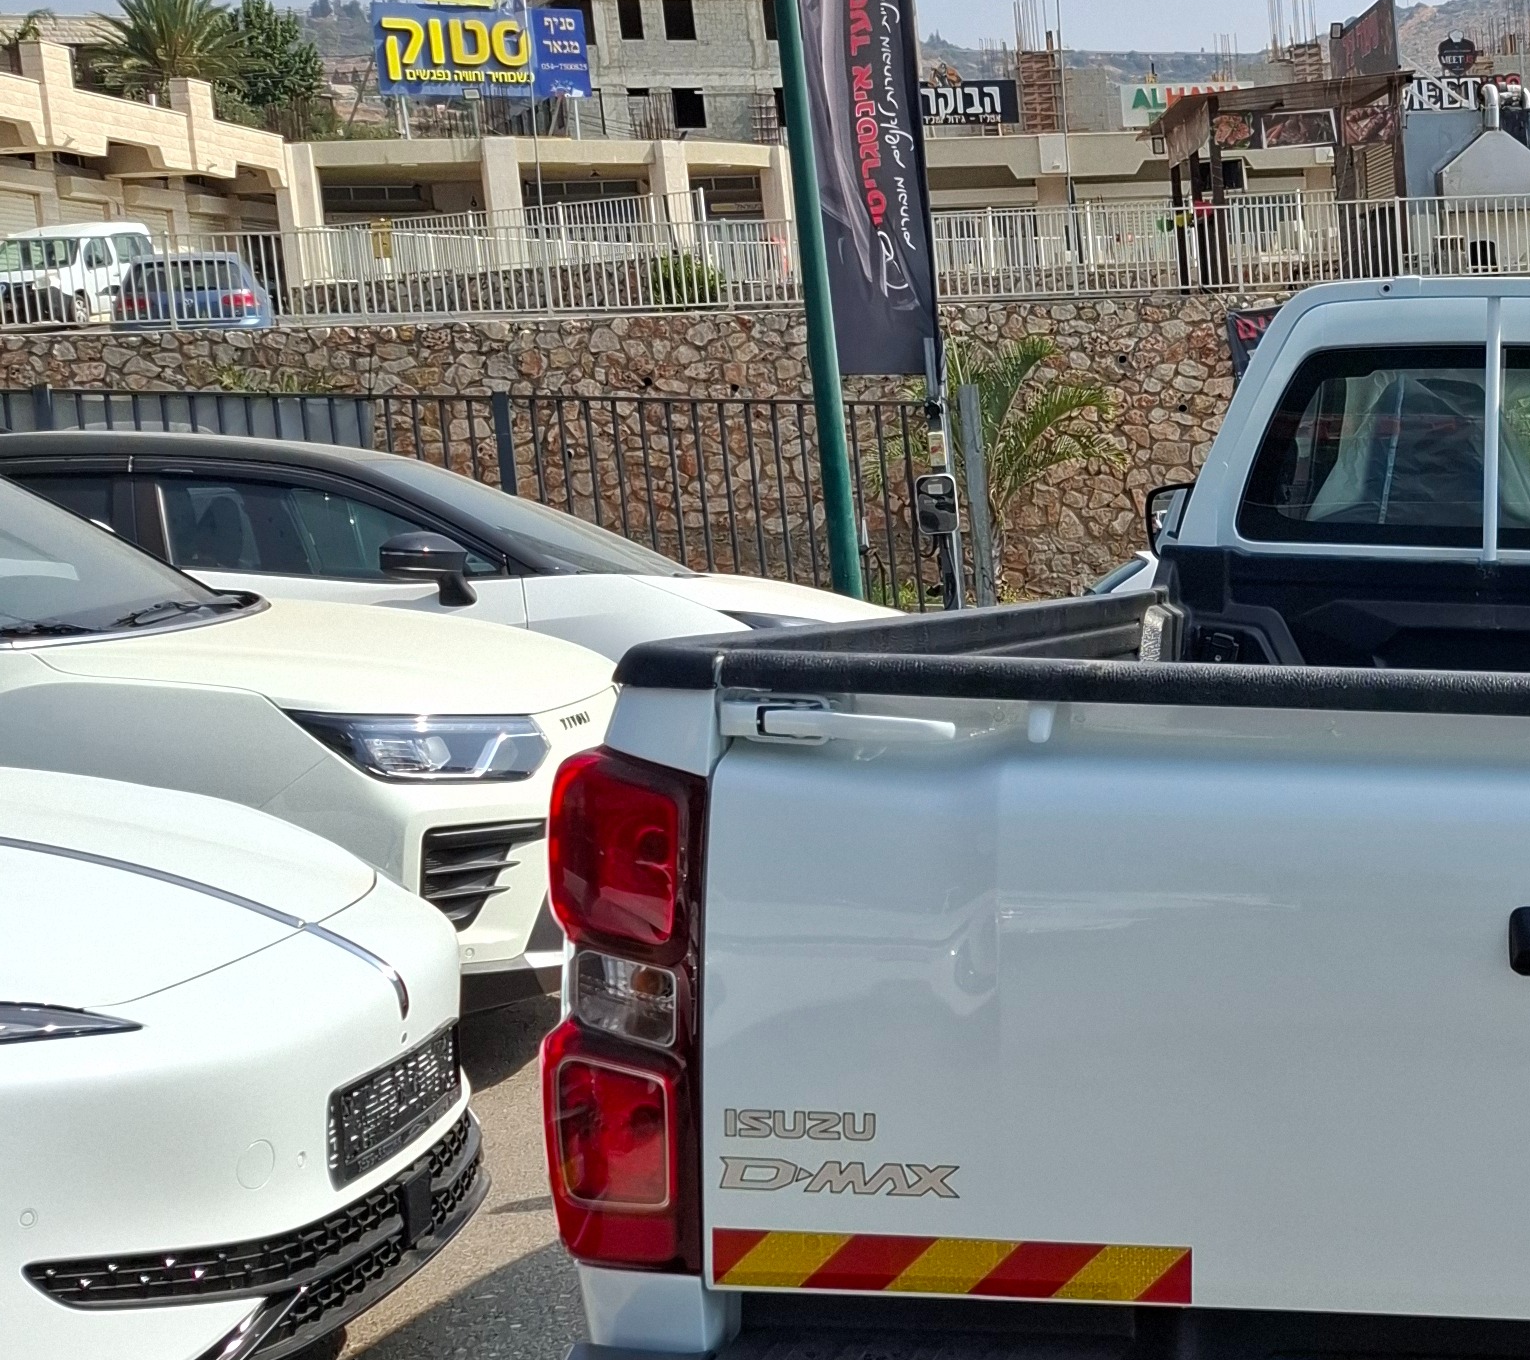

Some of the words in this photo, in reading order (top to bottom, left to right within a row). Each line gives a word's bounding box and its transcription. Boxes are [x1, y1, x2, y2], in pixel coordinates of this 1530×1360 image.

[543, 17, 576, 35] סניף
[381, 17, 531, 81] סטוק
[542, 39, 581, 54] מגאר
[405, 68, 451, 82] נפגשים
[880, 36, 899, 110] מובחרות
[894, 176, 917, 251] מובחרים
[724, 1108, 877, 1142] ISUZU
[719, 1156, 961, 1199] D-MAX
